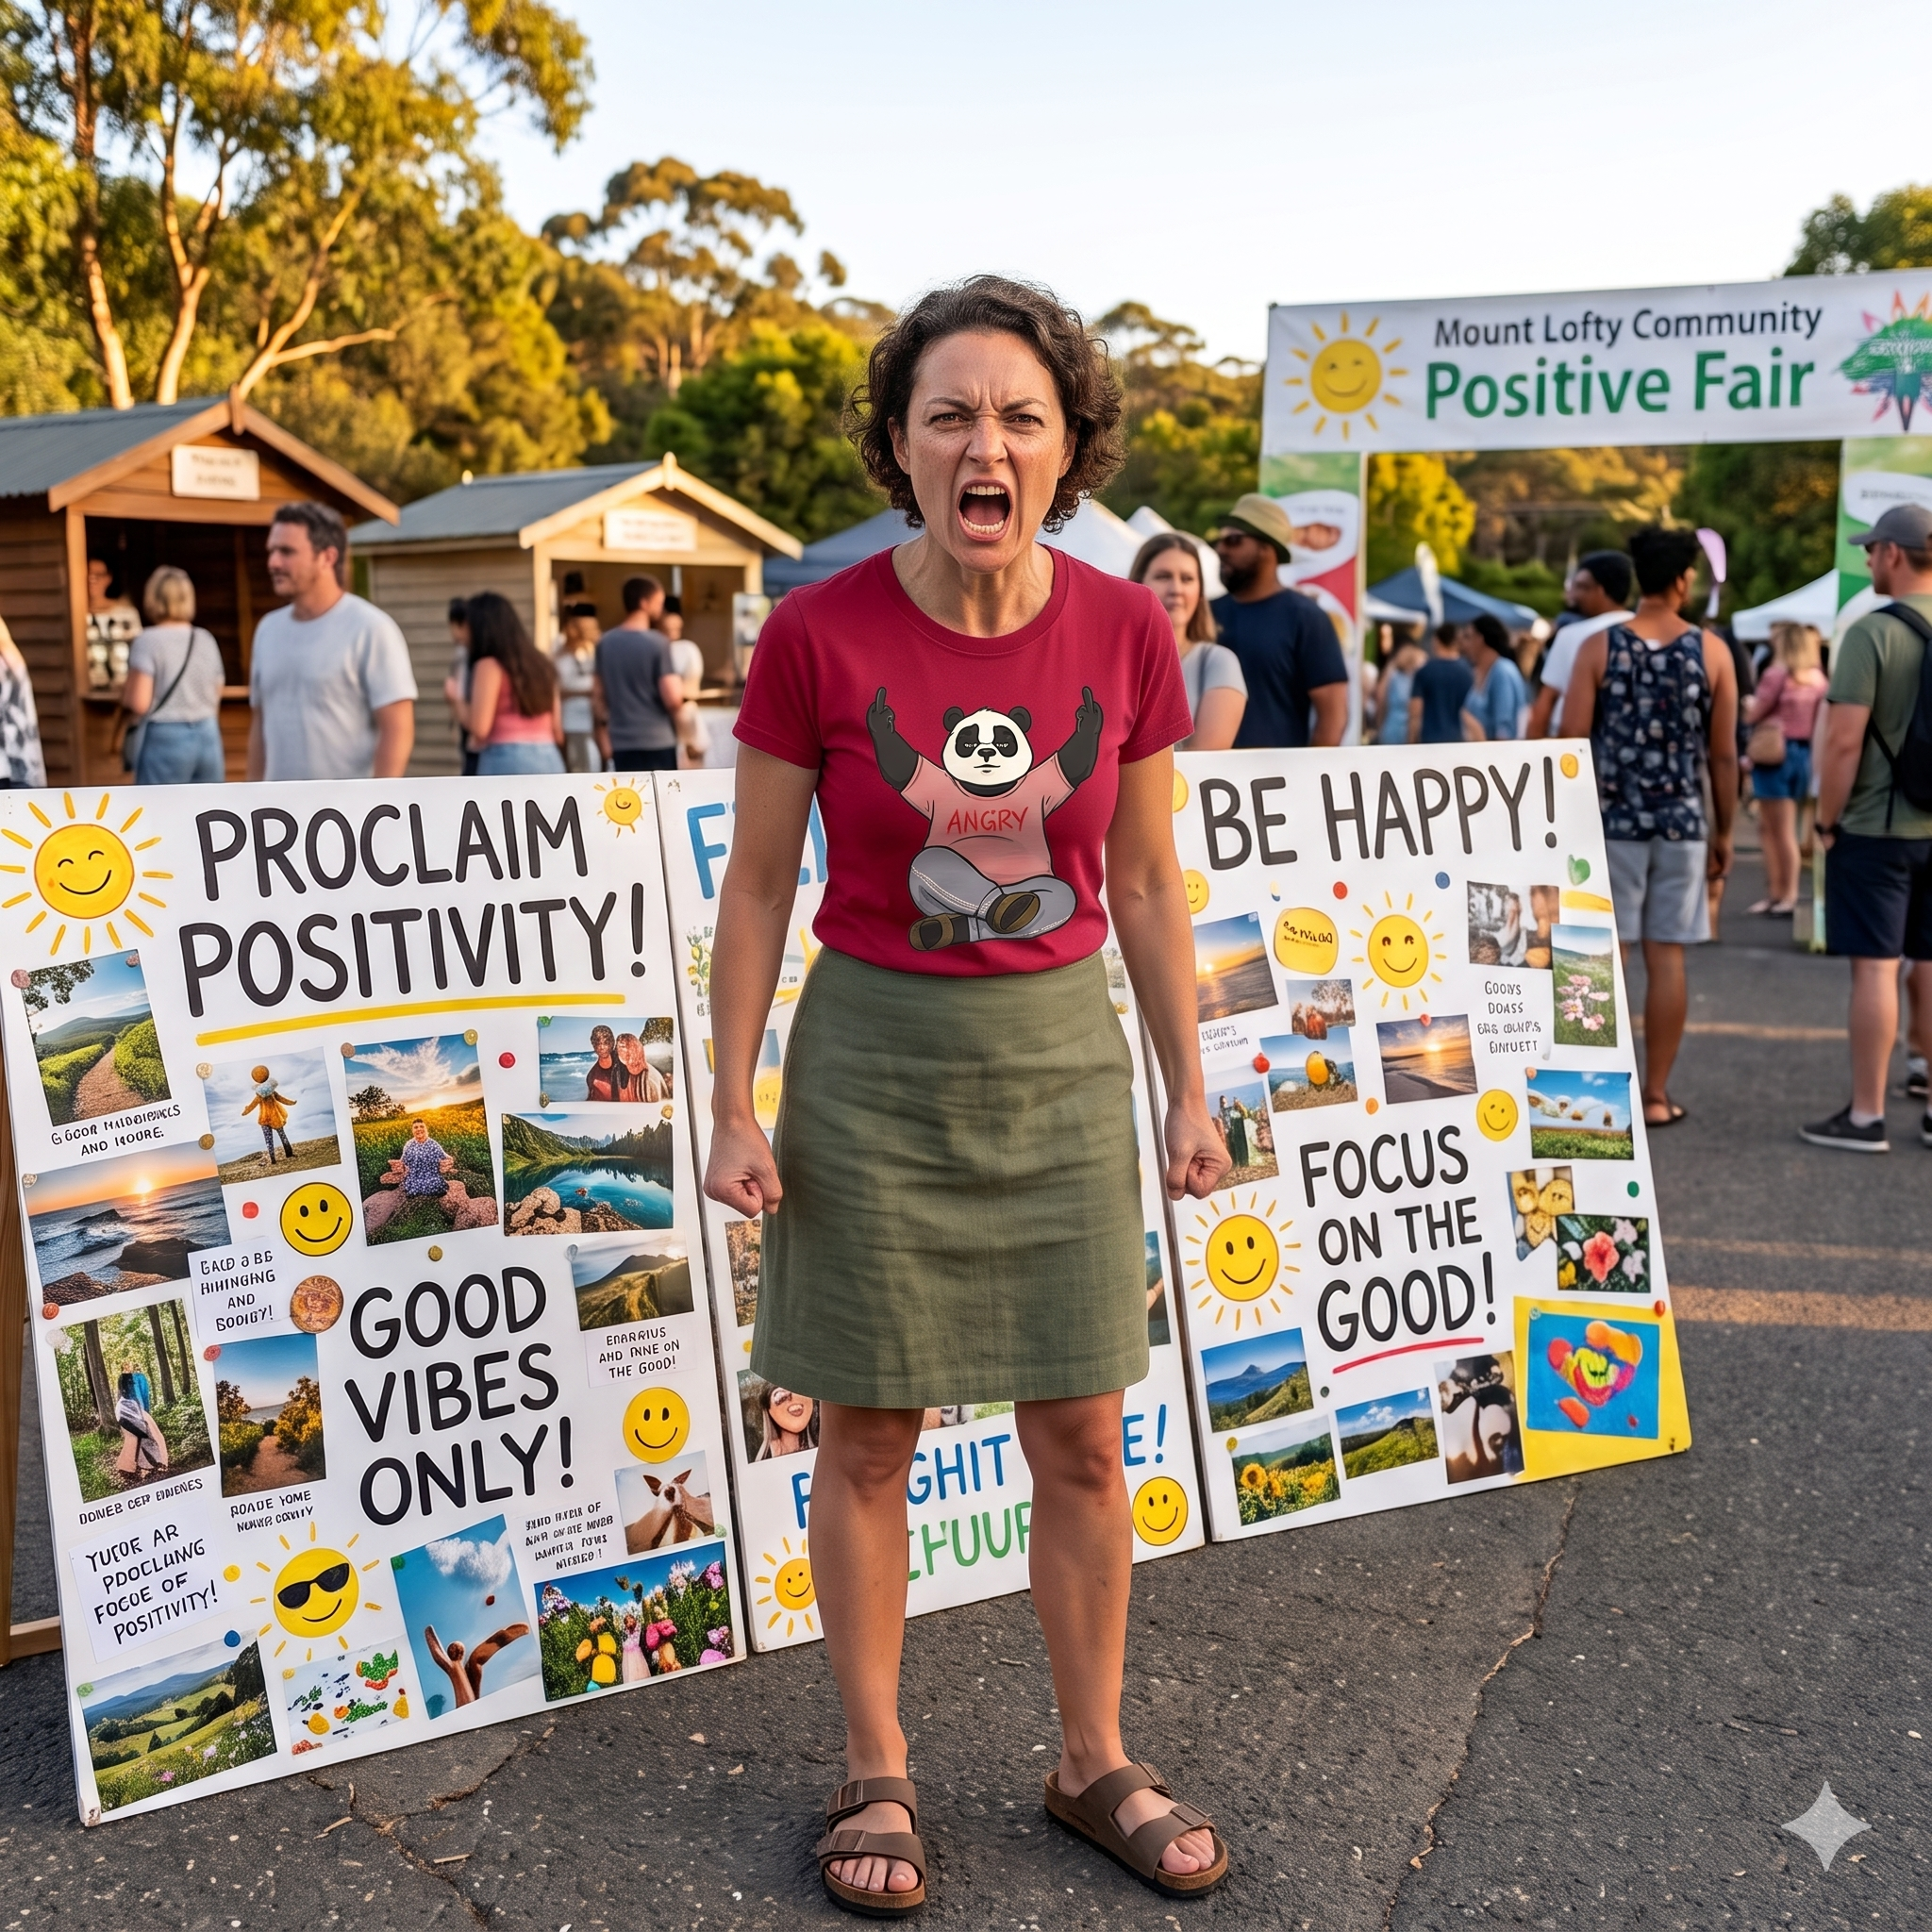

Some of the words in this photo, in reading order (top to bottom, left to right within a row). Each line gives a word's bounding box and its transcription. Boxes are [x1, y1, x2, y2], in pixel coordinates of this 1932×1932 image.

[1435, 319, 1535, 347] Mount
[1544, 312, 1622, 347] Lofty
[1633, 303, 1822, 340] Community
[1426, 355, 1670, 419] Positive
[1695, 346, 1814, 410] Fair
[195, 795, 588, 901] PROCLAIM
[946, 806, 1029, 834] ANGRY
[1199, 776, 1298, 870] BE
[1321, 756, 1557, 861] HAPPY!
[178, 883, 646, 1017] POSITIVITY!
[81, 1141, 108, 1156] AND
[1300, 1125, 1469, 1208] FOCUS
[1318, 1212, 1382, 1266] ON
[1394, 1196, 1483, 1254] THE
[227, 1293, 256, 1309] AND
[350, 1267, 546, 1358] GOOD
[1317, 1252, 1496, 1352] GOOD!
[344, 1343, 558, 1442] VIBES
[608, 1364, 632, 1378] THE
[639, 1356, 676, 1374] GOOD!
[359, 1416, 574, 1525] ONLY!
[154, 1524, 179, 1547] AR
[113, 1579, 218, 1644] POSITIVITY!
